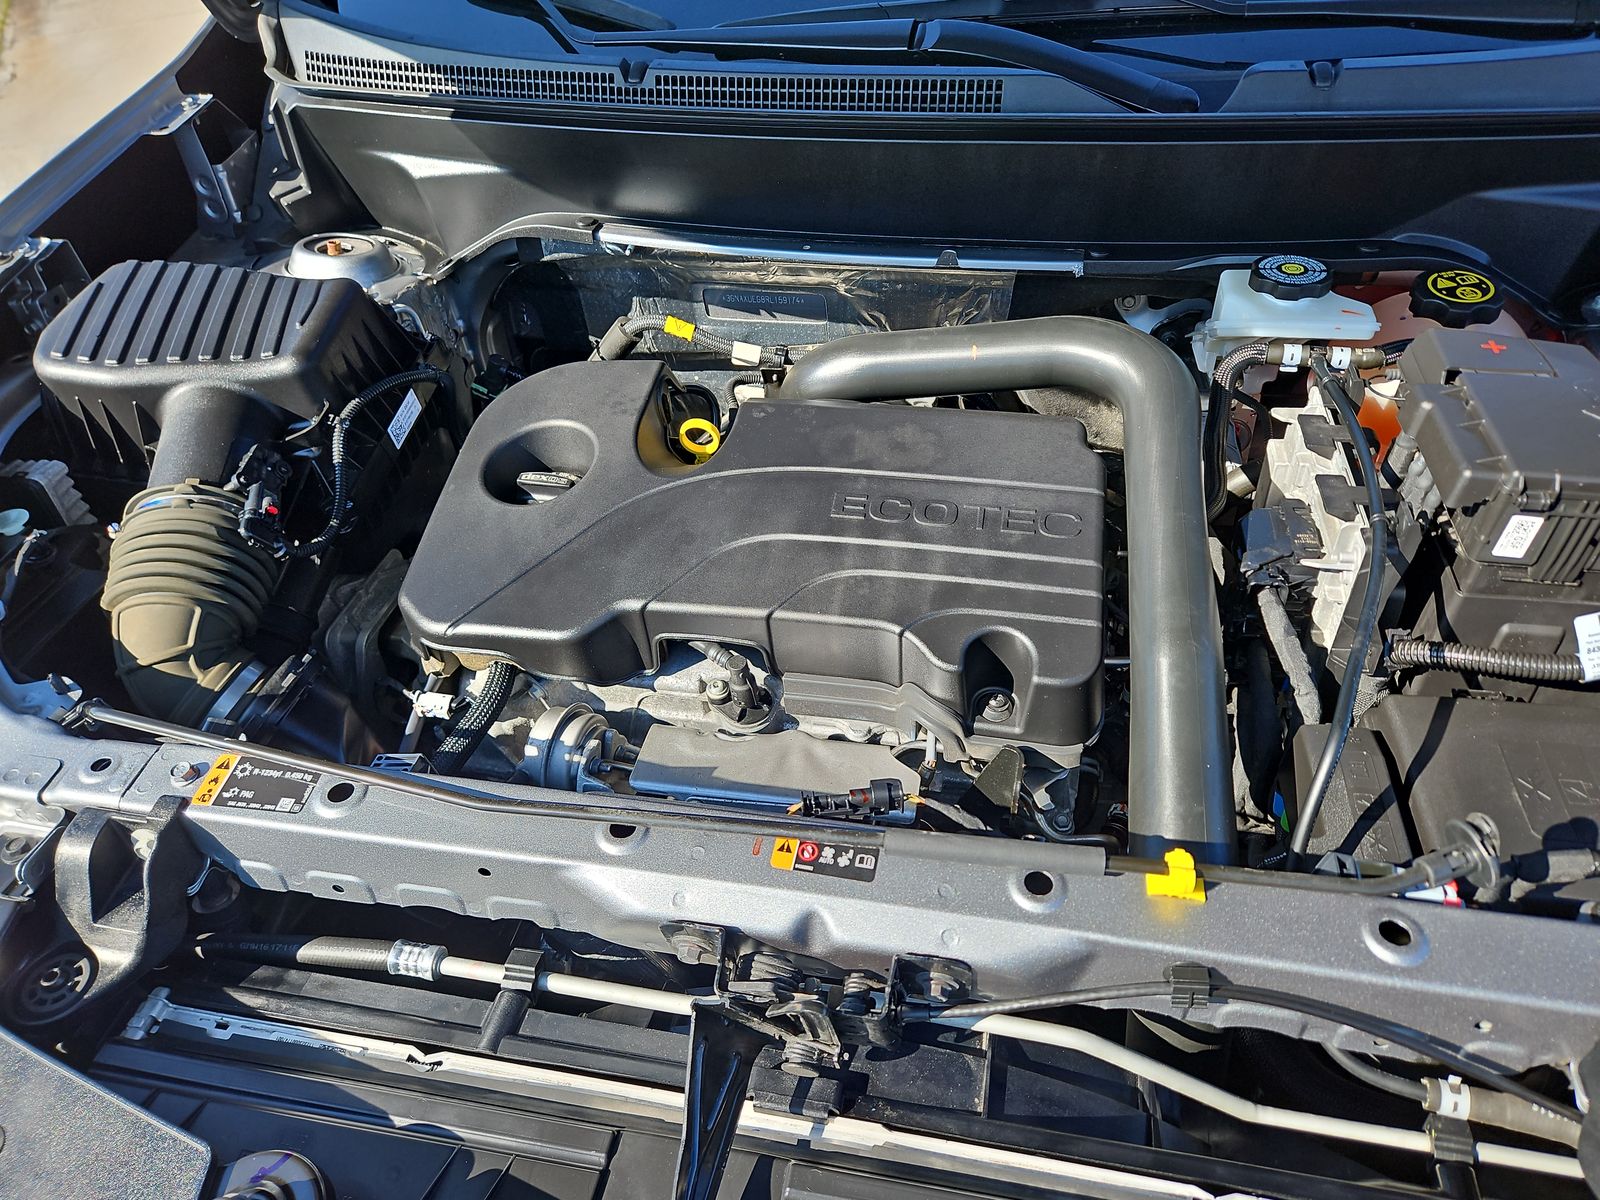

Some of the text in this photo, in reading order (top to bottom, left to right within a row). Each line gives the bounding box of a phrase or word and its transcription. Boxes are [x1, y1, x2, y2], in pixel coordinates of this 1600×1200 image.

[520, 473, 569, 485] dexos
[831, 493, 1083, 539] ECOTEC
[239, 790, 255, 799] PAG
[818, 857, 835, 865] AUTO
